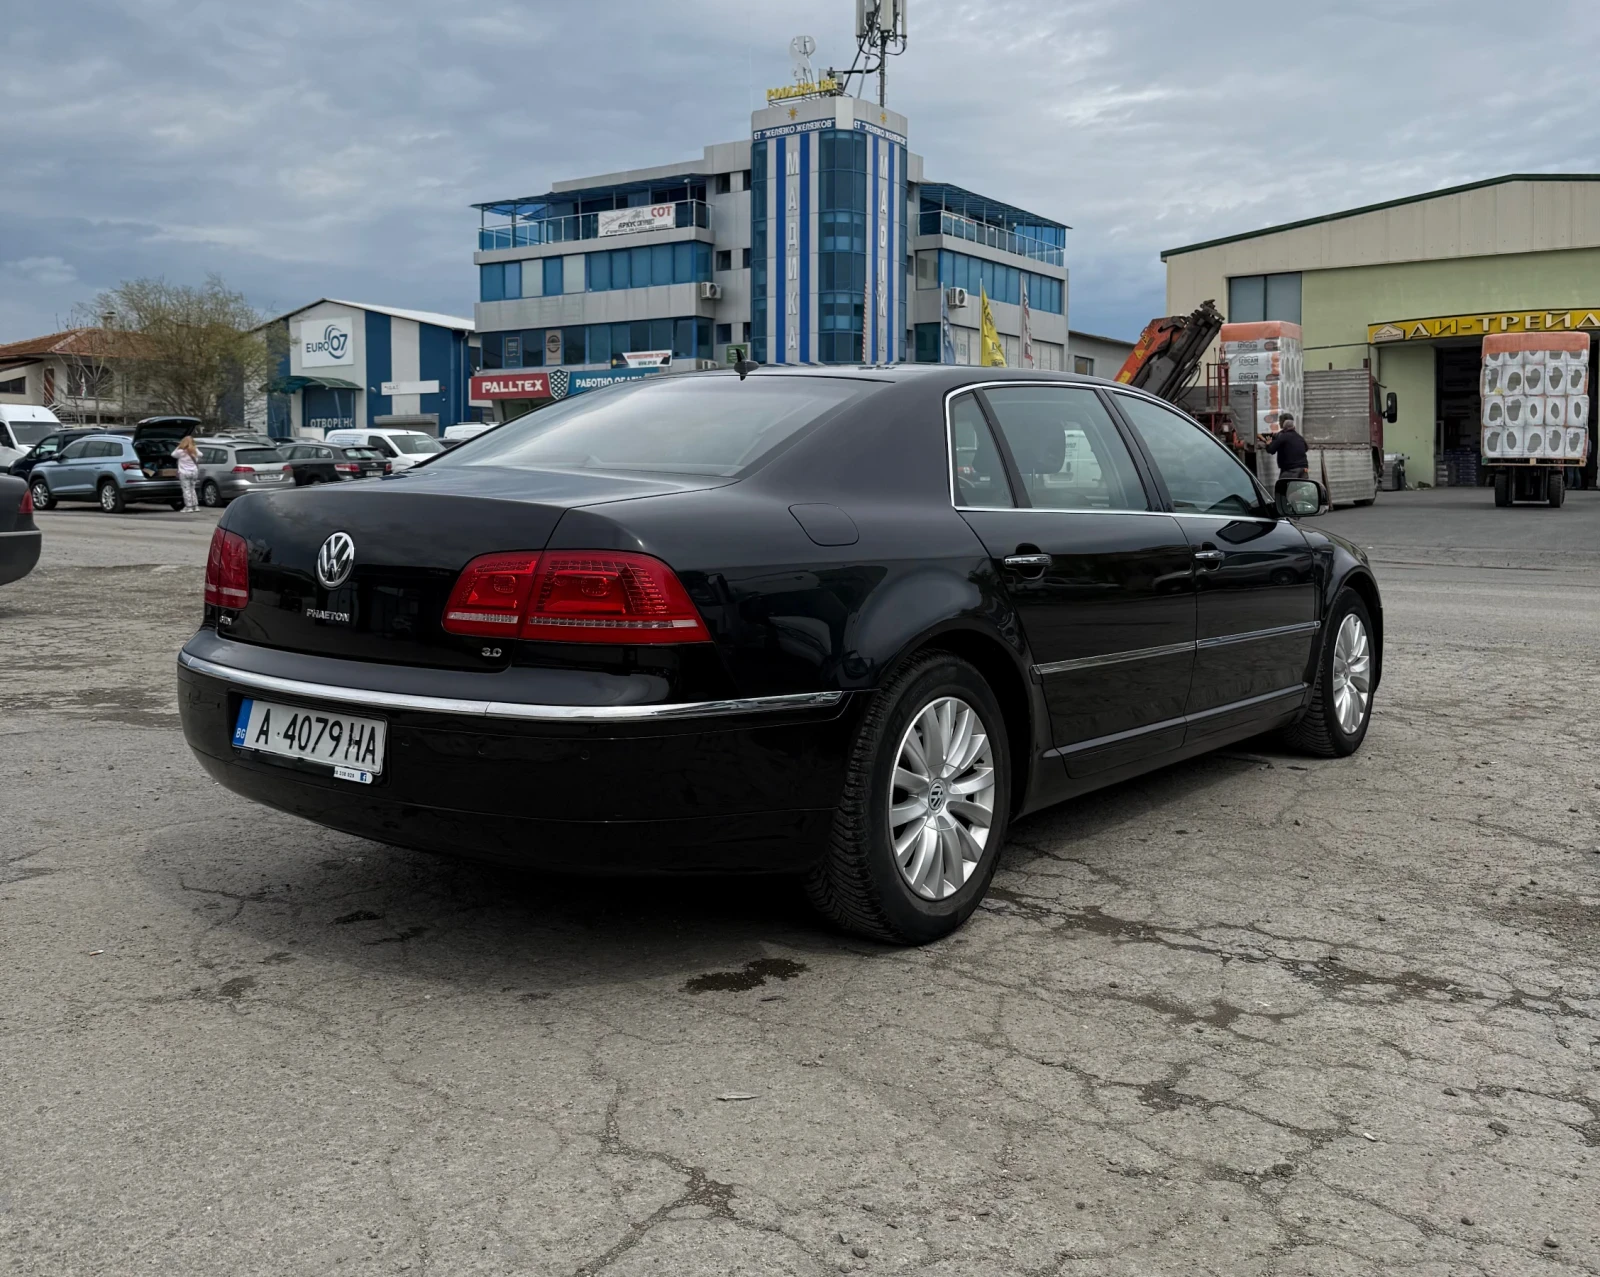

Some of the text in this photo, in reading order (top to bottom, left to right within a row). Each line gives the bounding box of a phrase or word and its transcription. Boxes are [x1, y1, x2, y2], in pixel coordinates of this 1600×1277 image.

[754, 131, 762, 140] ЕТ
[651, 205, 673, 218] СОТ
[787, 151, 799, 350] МАДИКА
[878, 154, 888, 352] MADIKA
[306, 341, 330, 353] EURO
[482, 379, 543, 394] PALLTEX
[306, 608, 350, 622] PHAETON
[235, 727, 246, 739] BG
